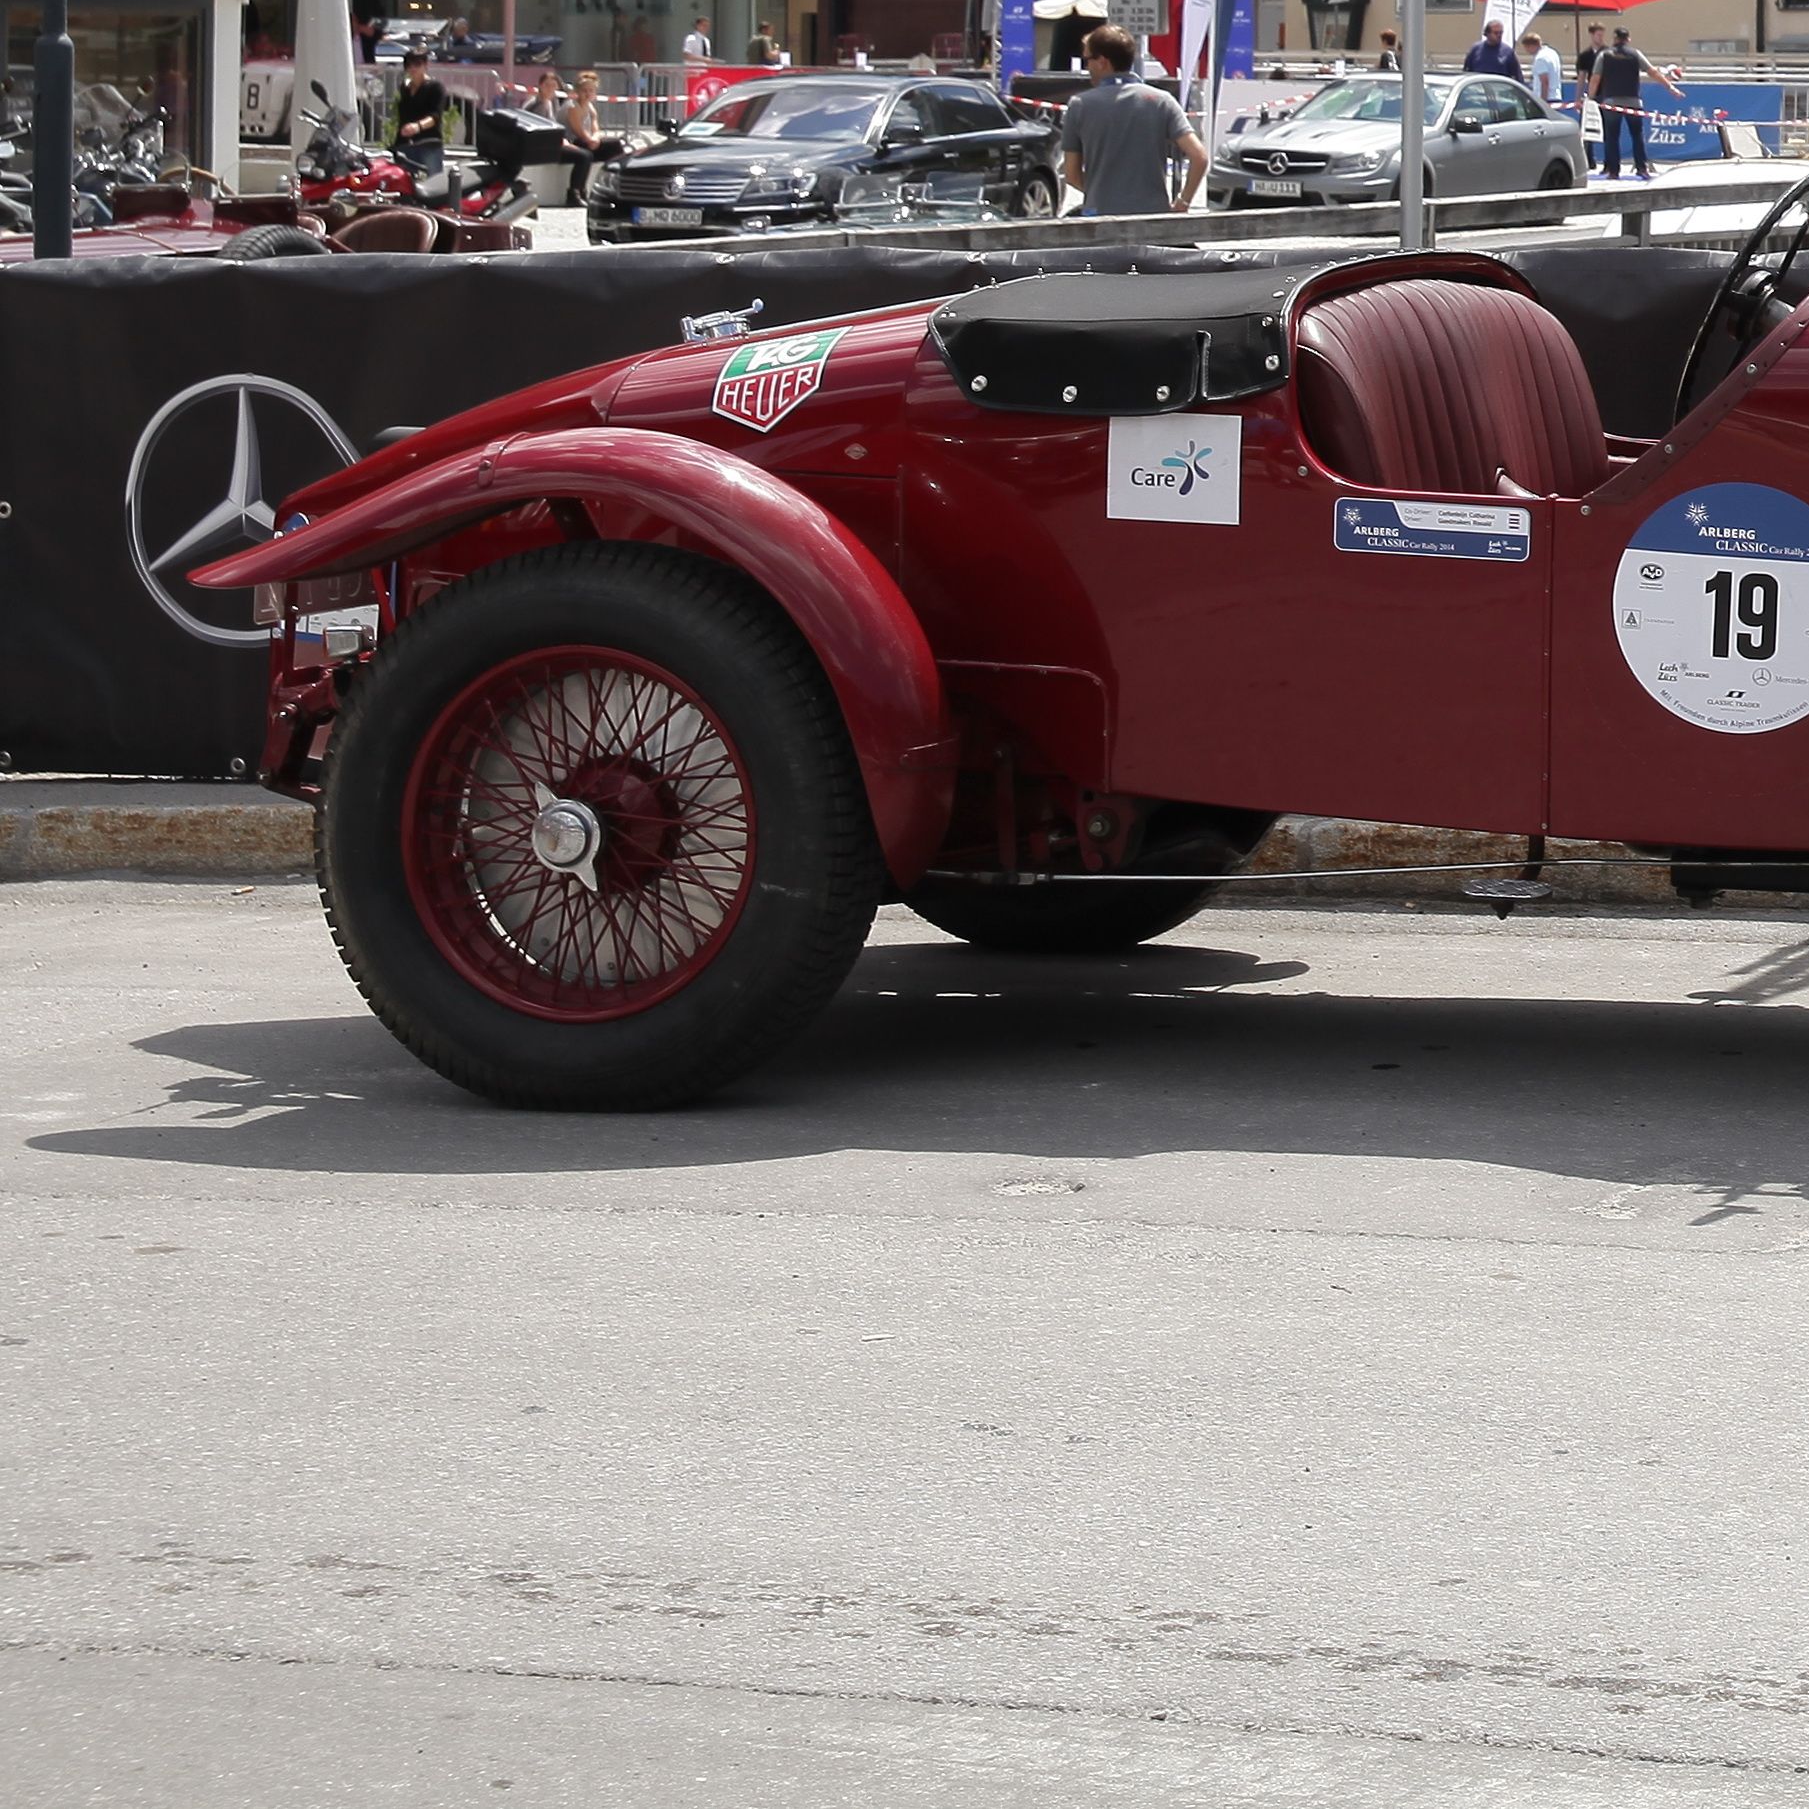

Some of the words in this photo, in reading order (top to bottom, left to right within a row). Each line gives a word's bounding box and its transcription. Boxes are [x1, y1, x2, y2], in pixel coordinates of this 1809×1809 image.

[247, 83, 260, 109] 8
[1649, 127, 1686, 144] Zürs
[745, 334, 820, 372] TAG
[722, 365, 815, 421] HEUER
[1131, 467, 1175, 488] Care
[1354, 525, 1399, 537] ARLBERG
[1698, 525, 1755, 540] ARLBERG
[1367, 536, 1409, 549] CLASSIC
[1410, 541, 1421, 549] Car
[1422, 542, 1438, 552] Rally
[1439, 543, 1455, 552] 2014
[1715, 539, 1768, 554] CLASSIC
[1768, 545, 1783, 555] Car
[1784, 546, 1805, 558] Rally
[1705, 570, 1779, 661] 19
[1659, 662, 1678, 672] Lech
[1658, 672, 1678, 682] Zürs
[1706, 698, 1734, 708] CLASSIC
[1735, 700, 1760, 709] TRADER
